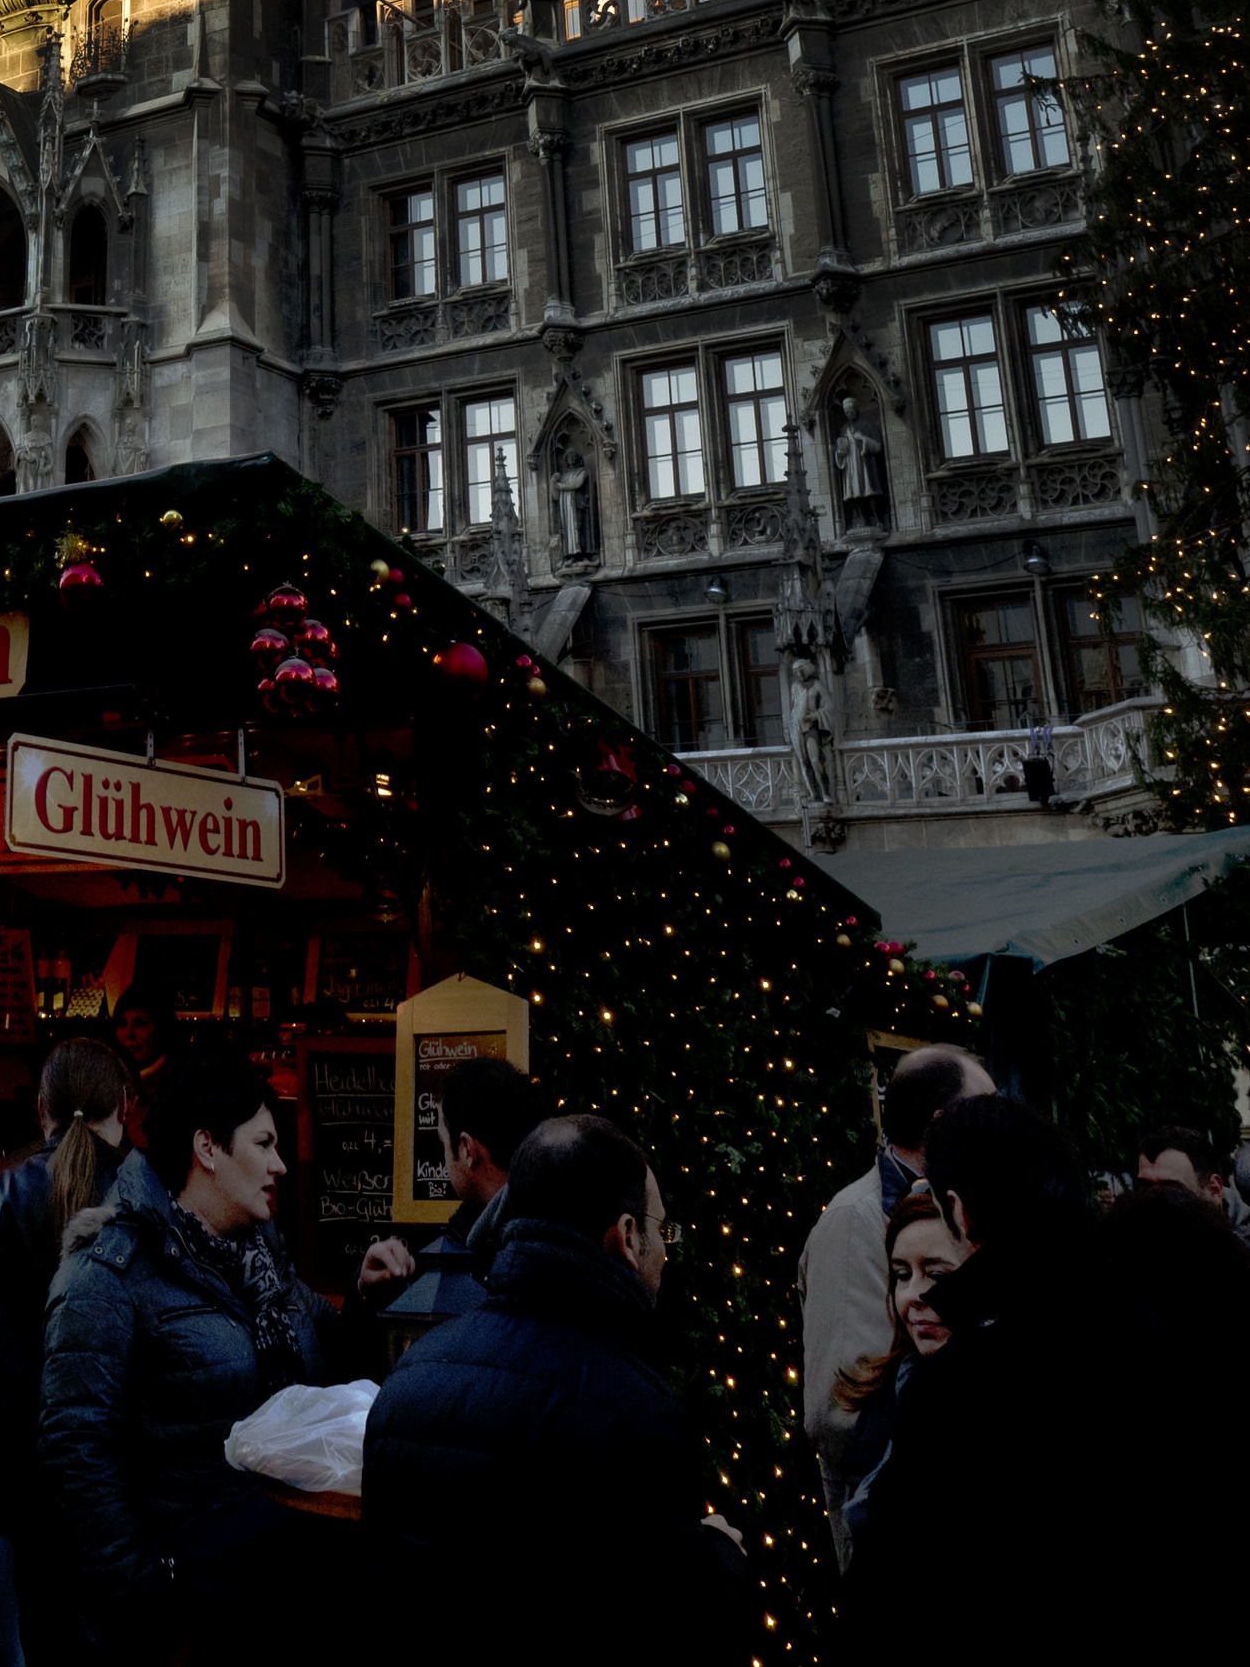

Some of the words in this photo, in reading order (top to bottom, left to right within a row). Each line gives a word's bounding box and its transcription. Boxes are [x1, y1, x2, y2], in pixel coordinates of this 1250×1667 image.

[34, 765, 264, 862] Glühwein
[417, 1038, 479, 1059] Glühwein
[417, 1111, 437, 1126] mit
